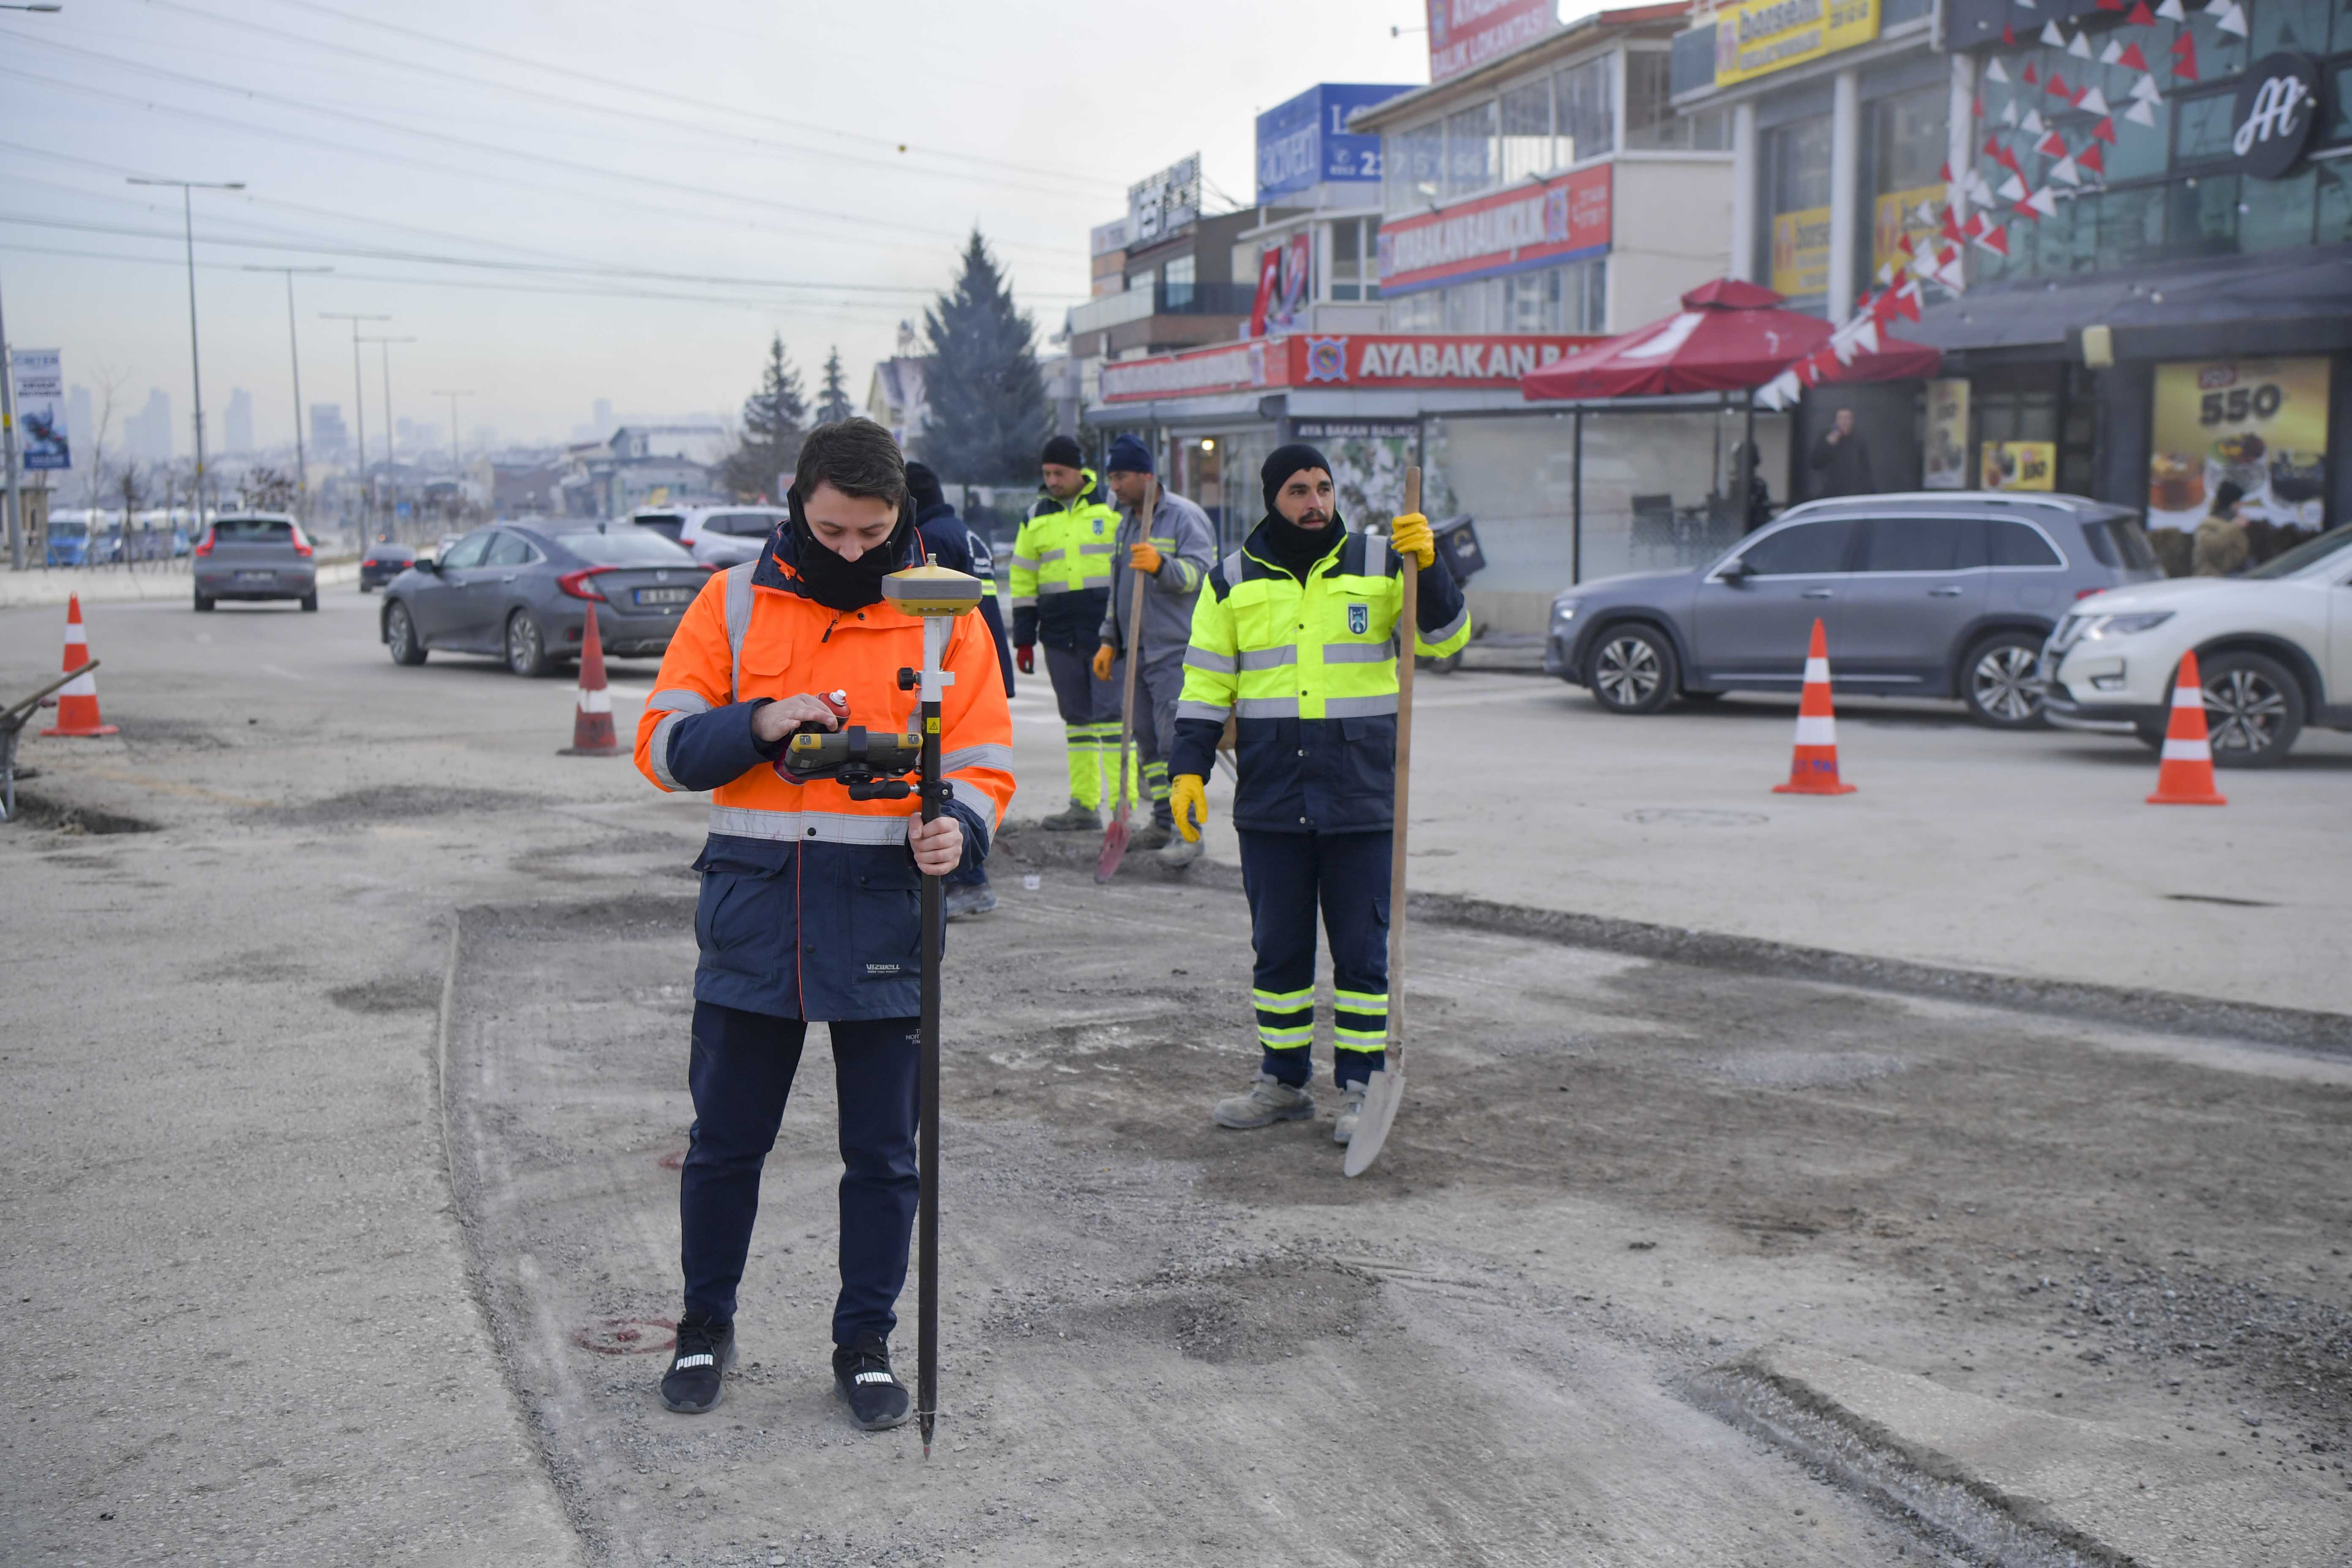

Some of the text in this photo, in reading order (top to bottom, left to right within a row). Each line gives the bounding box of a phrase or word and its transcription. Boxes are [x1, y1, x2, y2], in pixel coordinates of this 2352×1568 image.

[1358, 343, 1536, 378] AYABAKAN
[2201, 383, 2282, 427] 550
[1298, 423, 1323, 437] AYA
[1325, 423, 1369, 437] BAKAN
[676, 1354, 713, 1371] PUMA
[855, 1371, 893, 1386] PUMA
